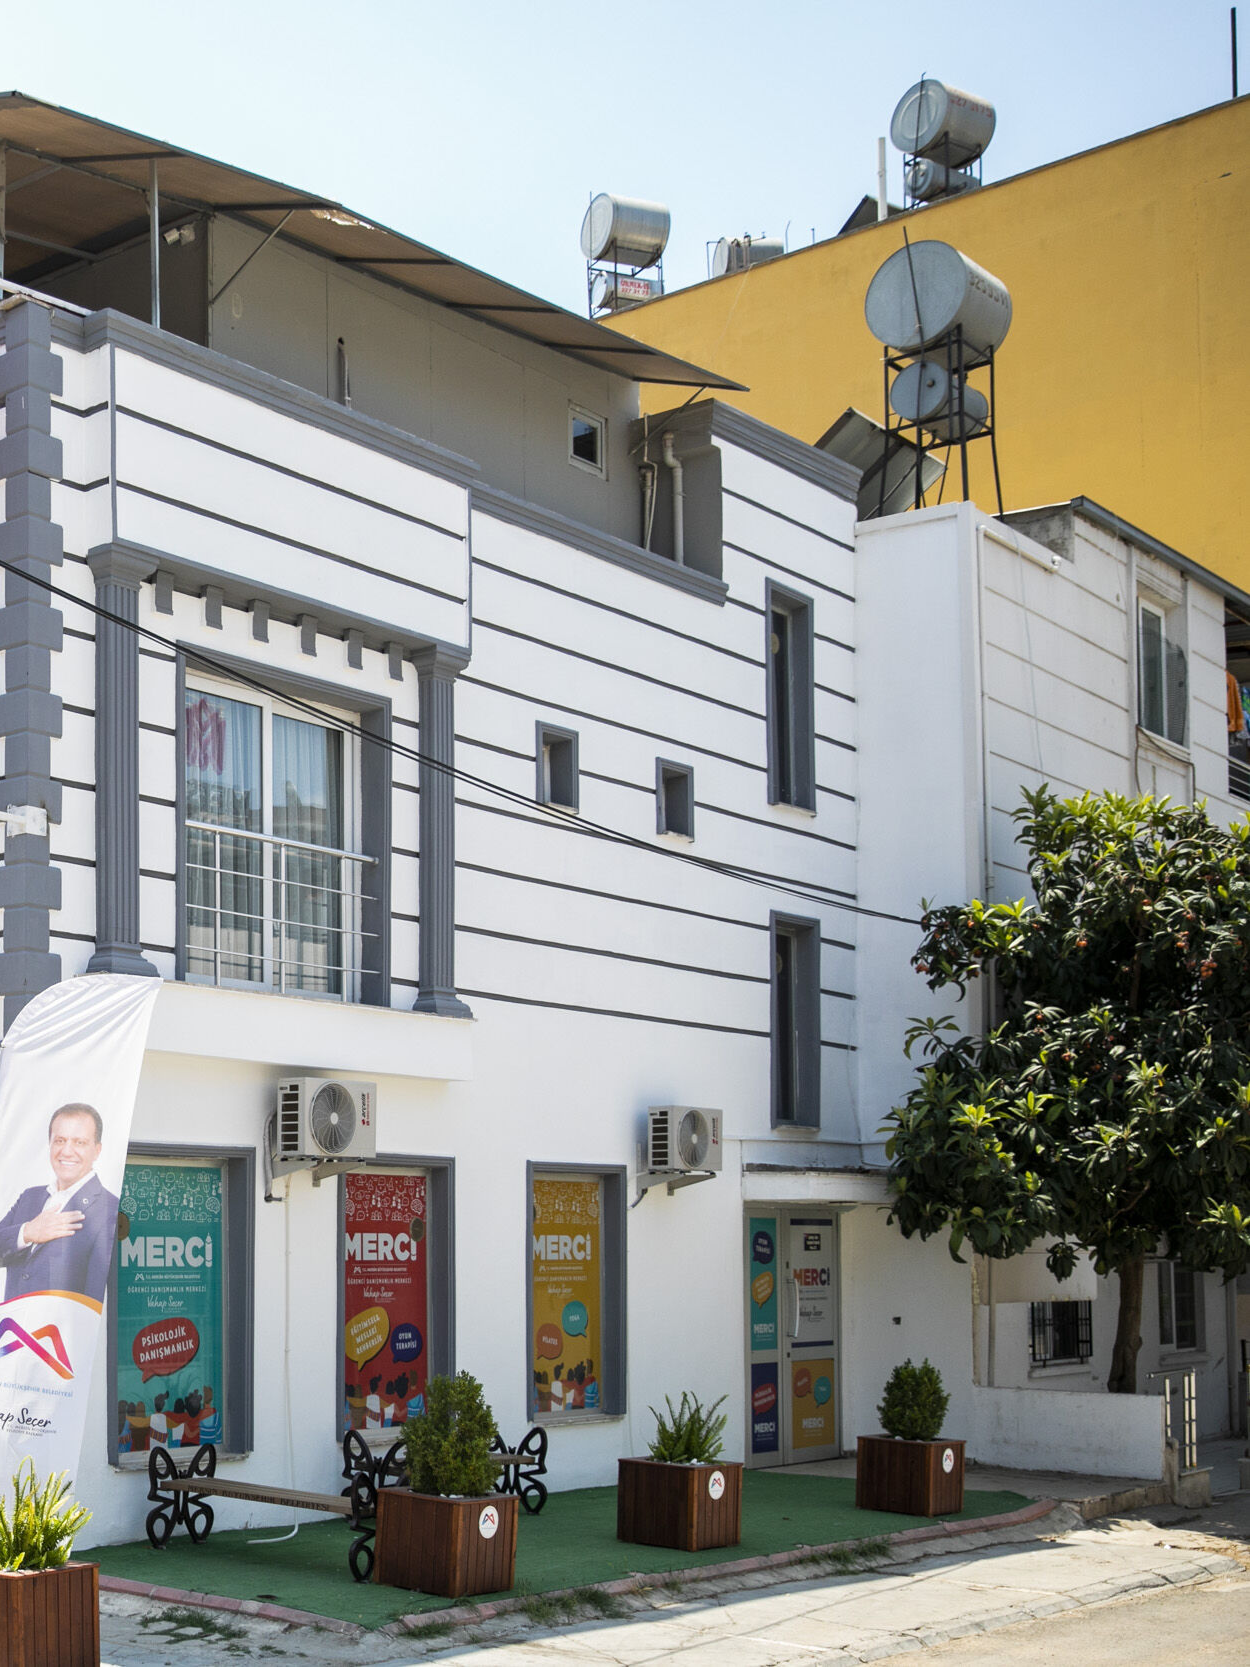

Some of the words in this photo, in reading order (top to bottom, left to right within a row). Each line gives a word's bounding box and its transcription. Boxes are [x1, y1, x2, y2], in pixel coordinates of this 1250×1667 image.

[141, 1325, 187, 1347] PSİKOLOJİK
[140, 1339, 194, 1363] DANIŞMANLIK
[17, 1407, 51, 1428] Seçer
